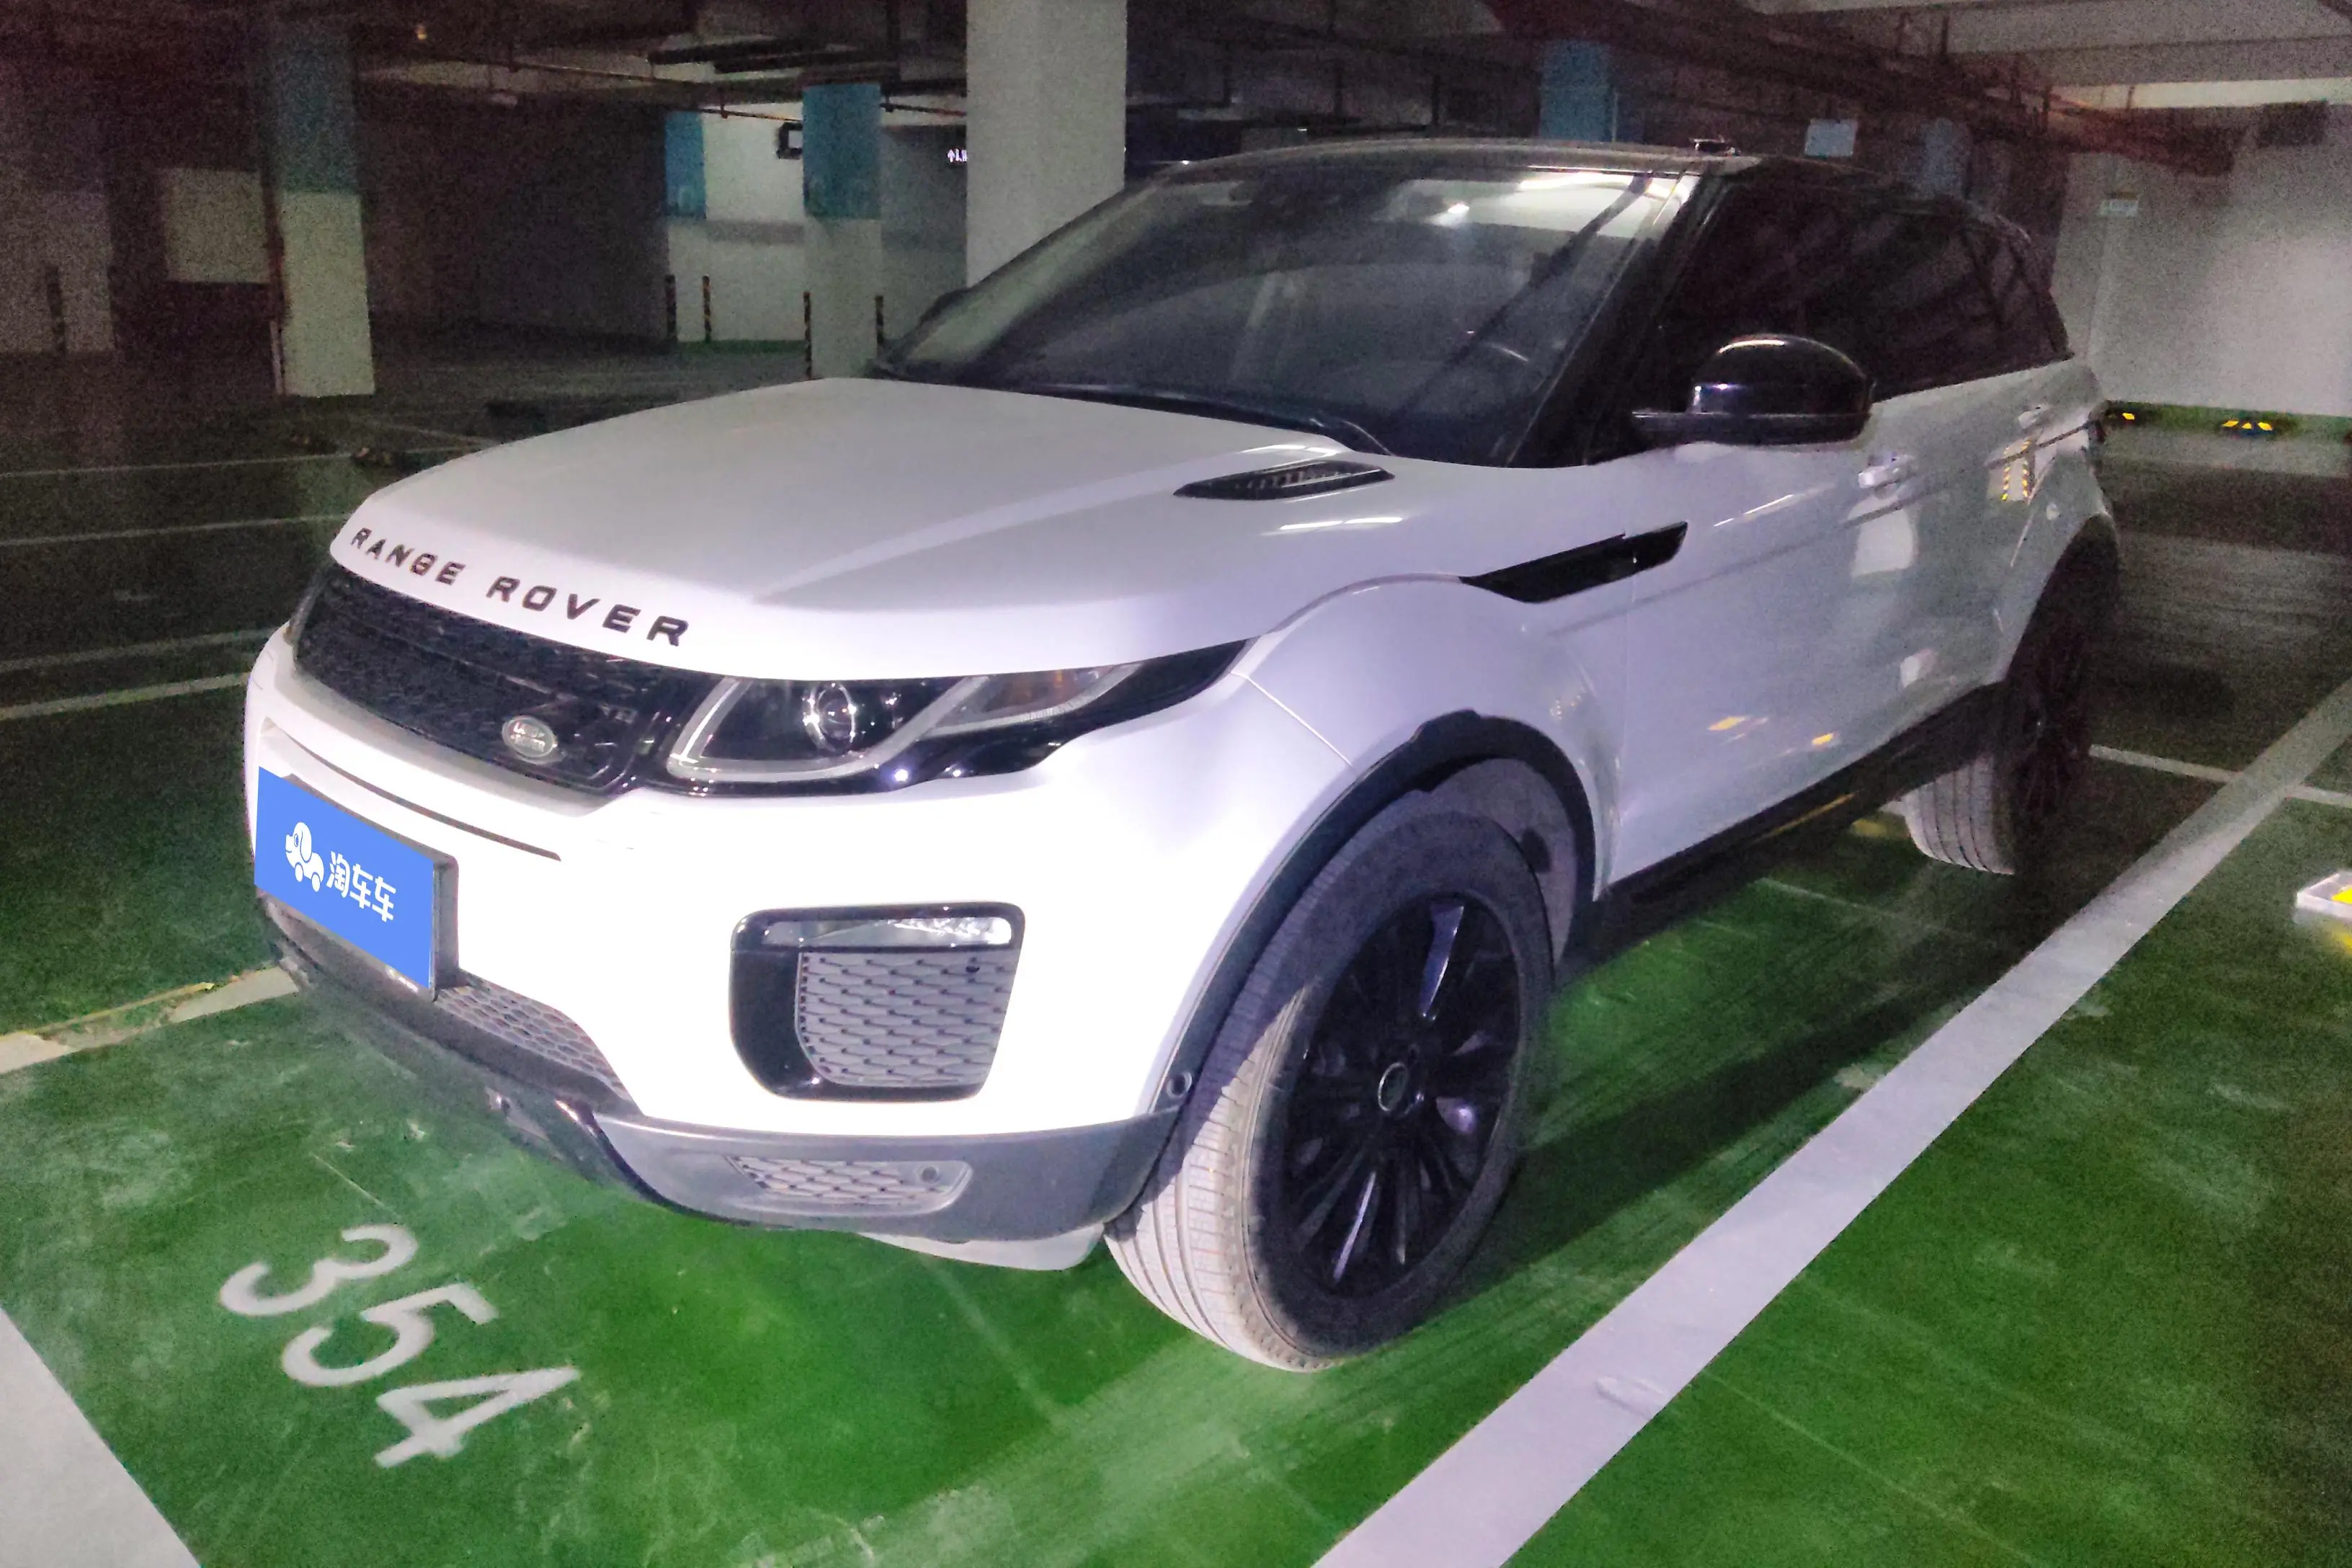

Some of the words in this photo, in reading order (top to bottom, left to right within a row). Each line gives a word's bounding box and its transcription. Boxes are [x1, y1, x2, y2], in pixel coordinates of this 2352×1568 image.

[351, 527, 466, 585] RANGE
[486, 576, 689, 646] ROVER
[220, 1225, 580, 1469] 354
